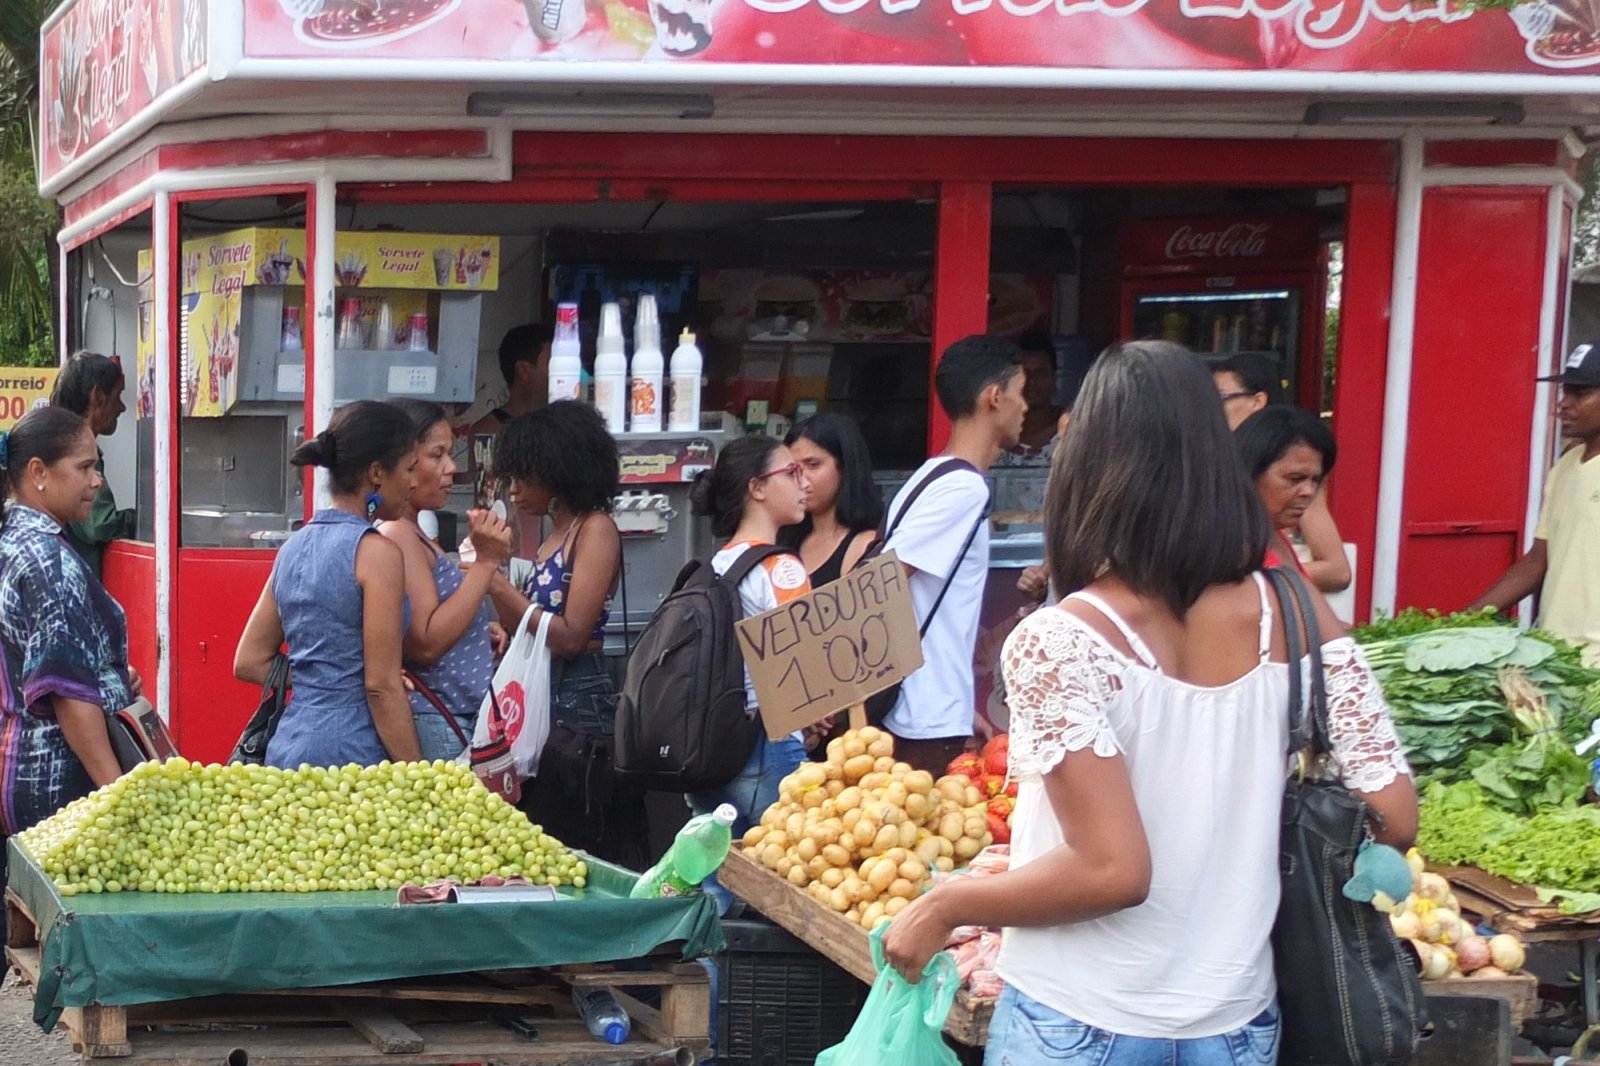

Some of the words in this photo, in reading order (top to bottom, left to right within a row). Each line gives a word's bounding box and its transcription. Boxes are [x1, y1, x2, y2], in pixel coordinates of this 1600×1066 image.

[91, 27, 132, 128] Legal
[206, 242, 252, 268] Sorvete
[376, 246, 425, 259] Sorvete
[382, 259, 420, 273] Legal
[211, 269, 246, 296] Legal
[739, 560, 901, 661] VERDURA
